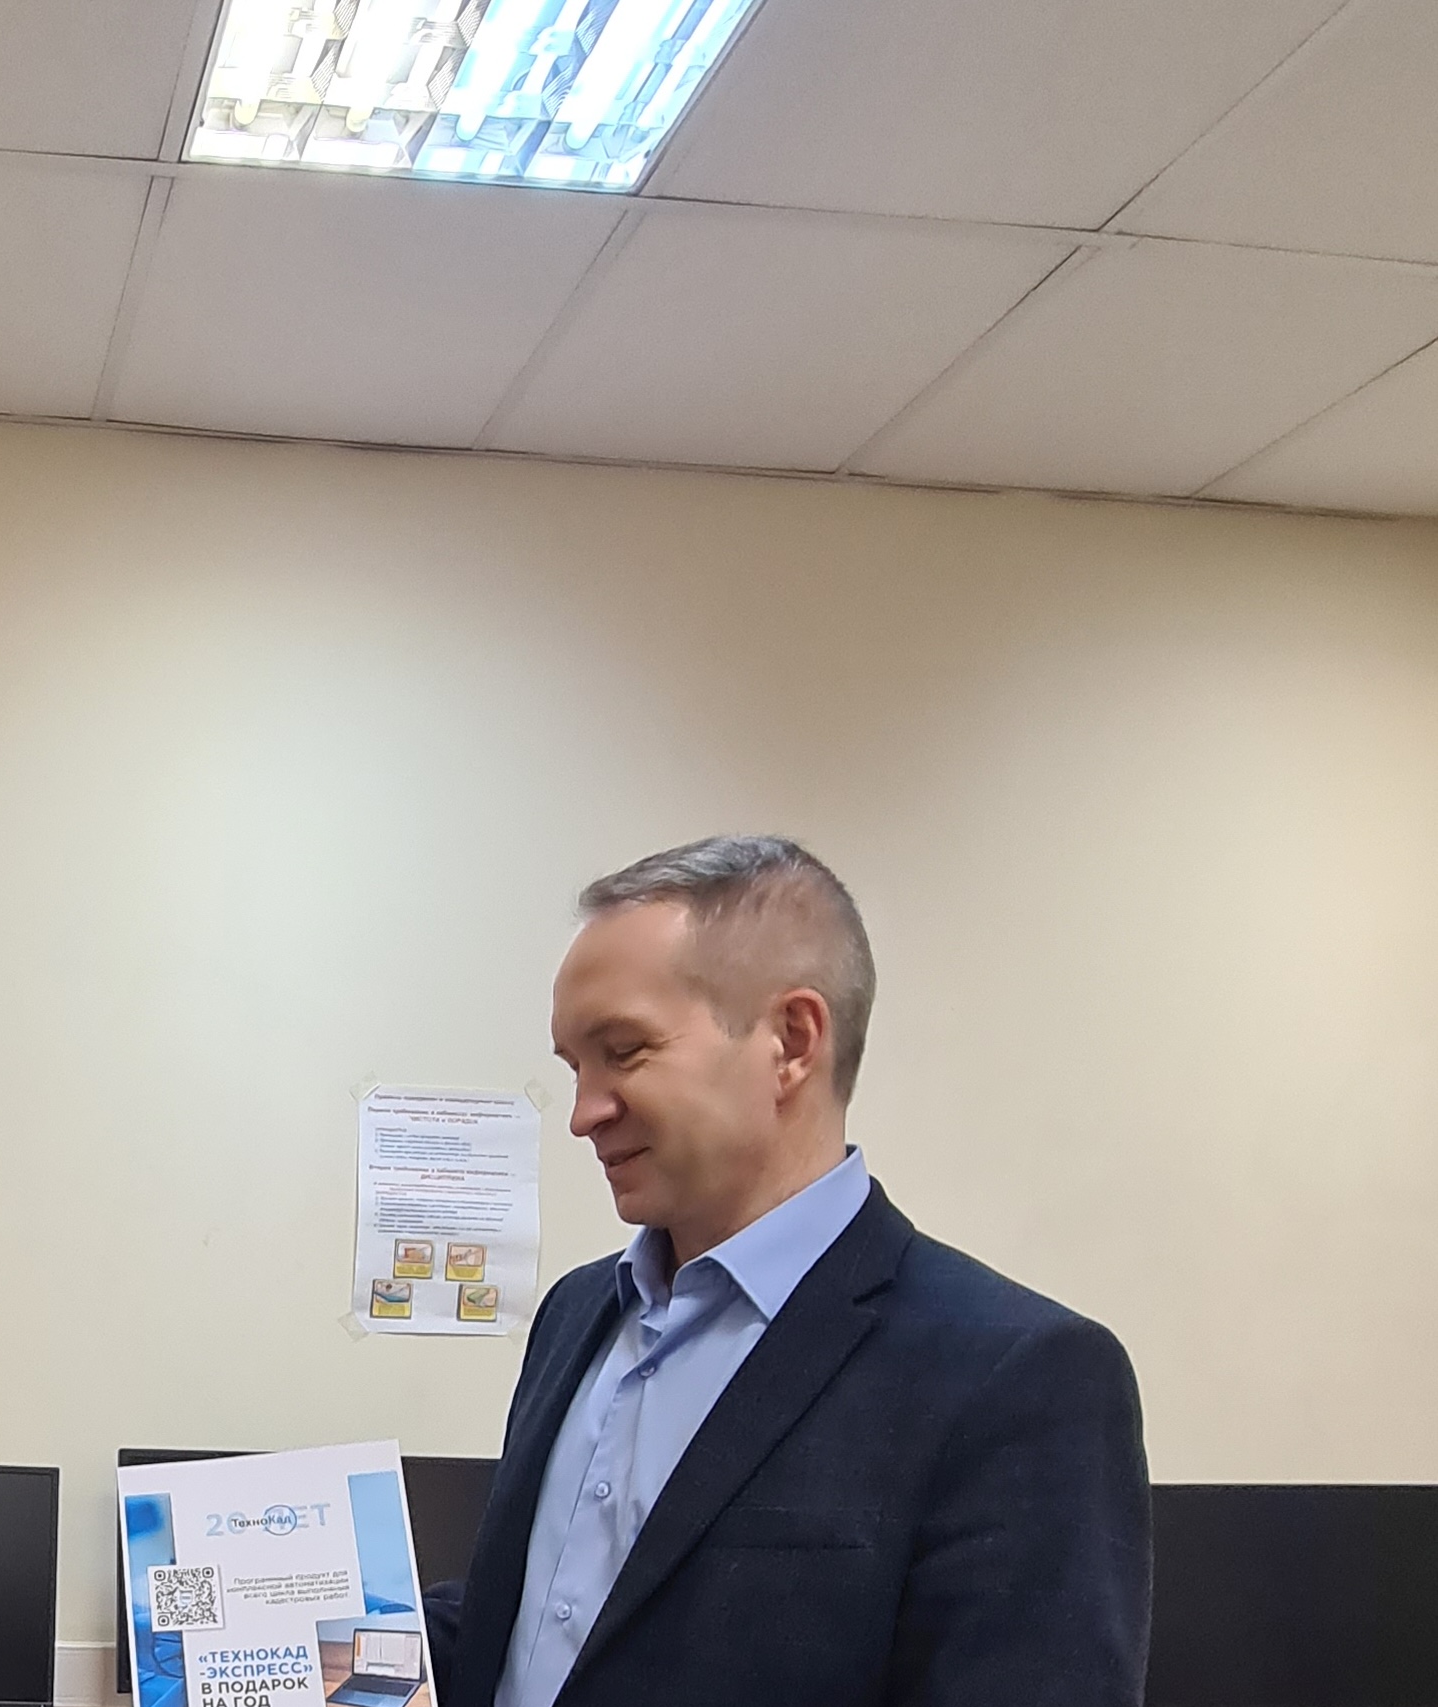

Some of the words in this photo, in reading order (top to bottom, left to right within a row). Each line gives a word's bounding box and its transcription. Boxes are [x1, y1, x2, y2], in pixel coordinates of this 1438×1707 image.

[198, 1645, 309, 1663] «ТЕХНОКАД
[199, 1661, 313, 1679] -ЭКСПРЕСС»
[201, 1682, 212, 1695] В
[218, 1676, 309, 1694] ПОДАРОК
